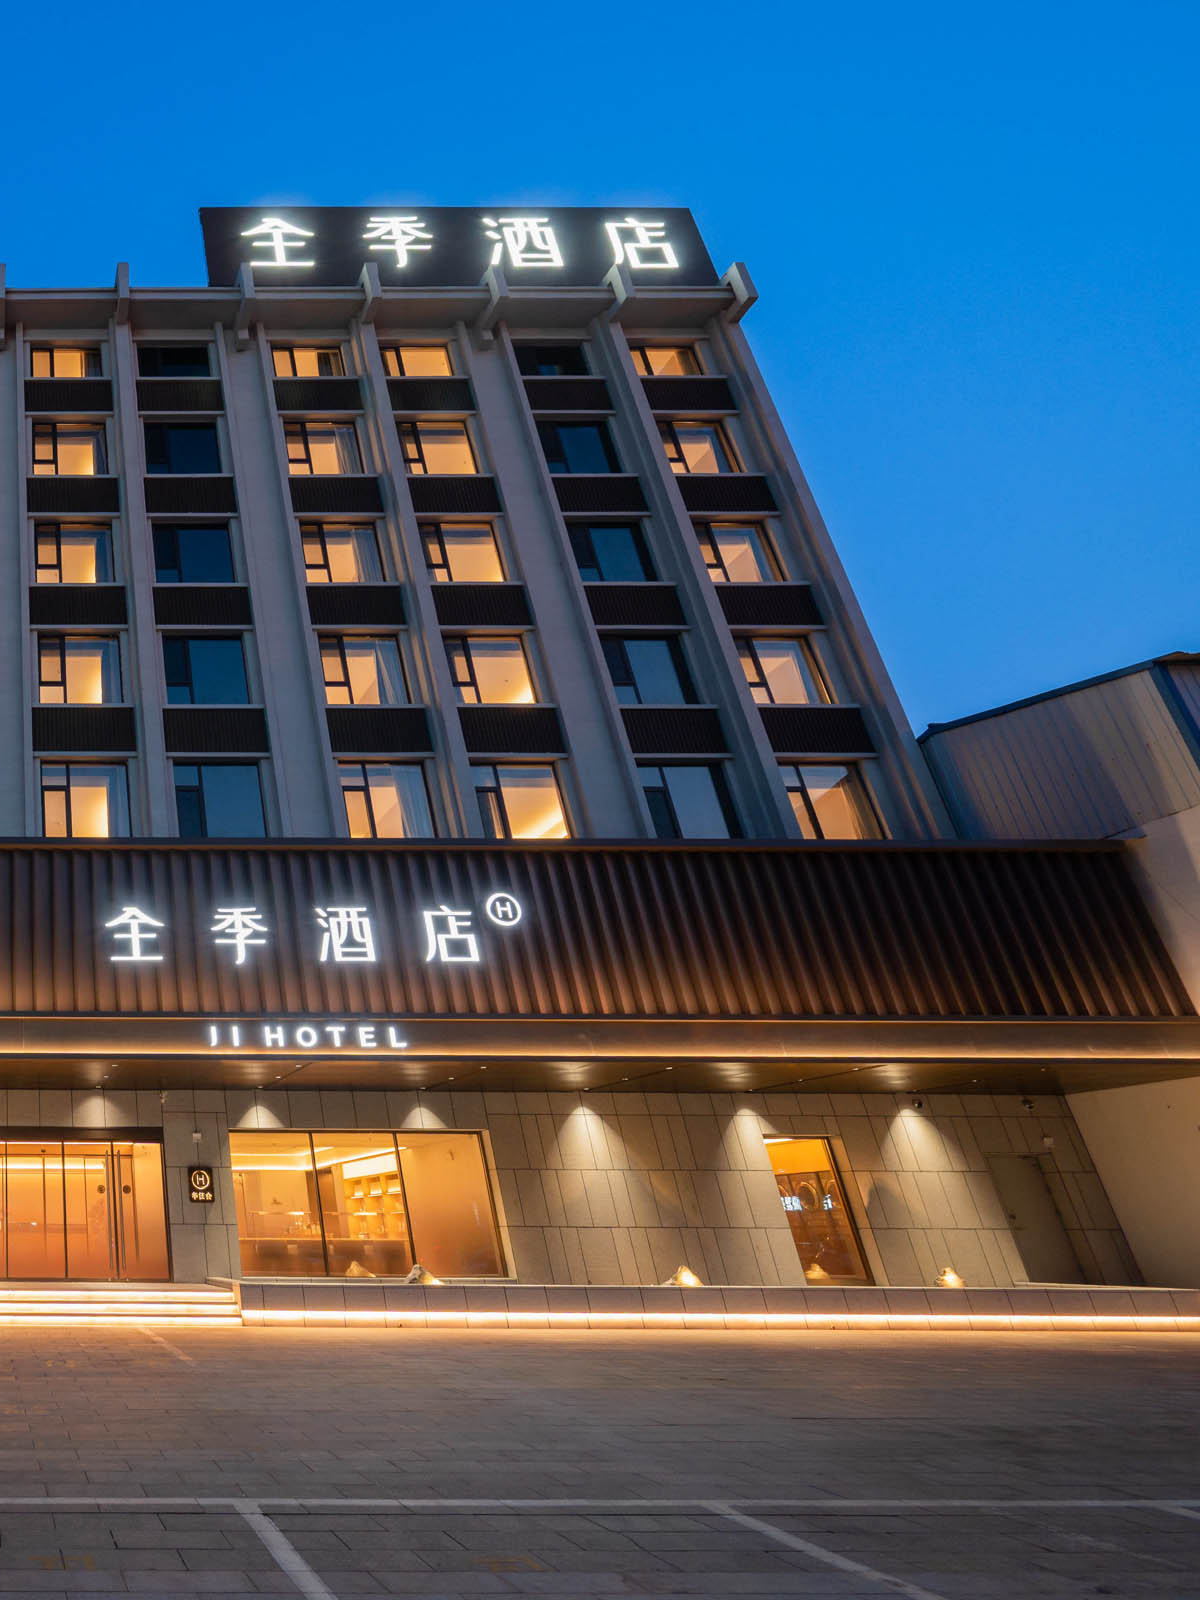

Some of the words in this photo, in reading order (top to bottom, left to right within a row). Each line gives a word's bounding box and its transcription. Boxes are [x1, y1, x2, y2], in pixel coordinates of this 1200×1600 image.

[240, 215, 679, 268] 全季酒店
[104, 904, 481, 965] 全季酒店
[263, 1025, 408, 1048] HOTEL
